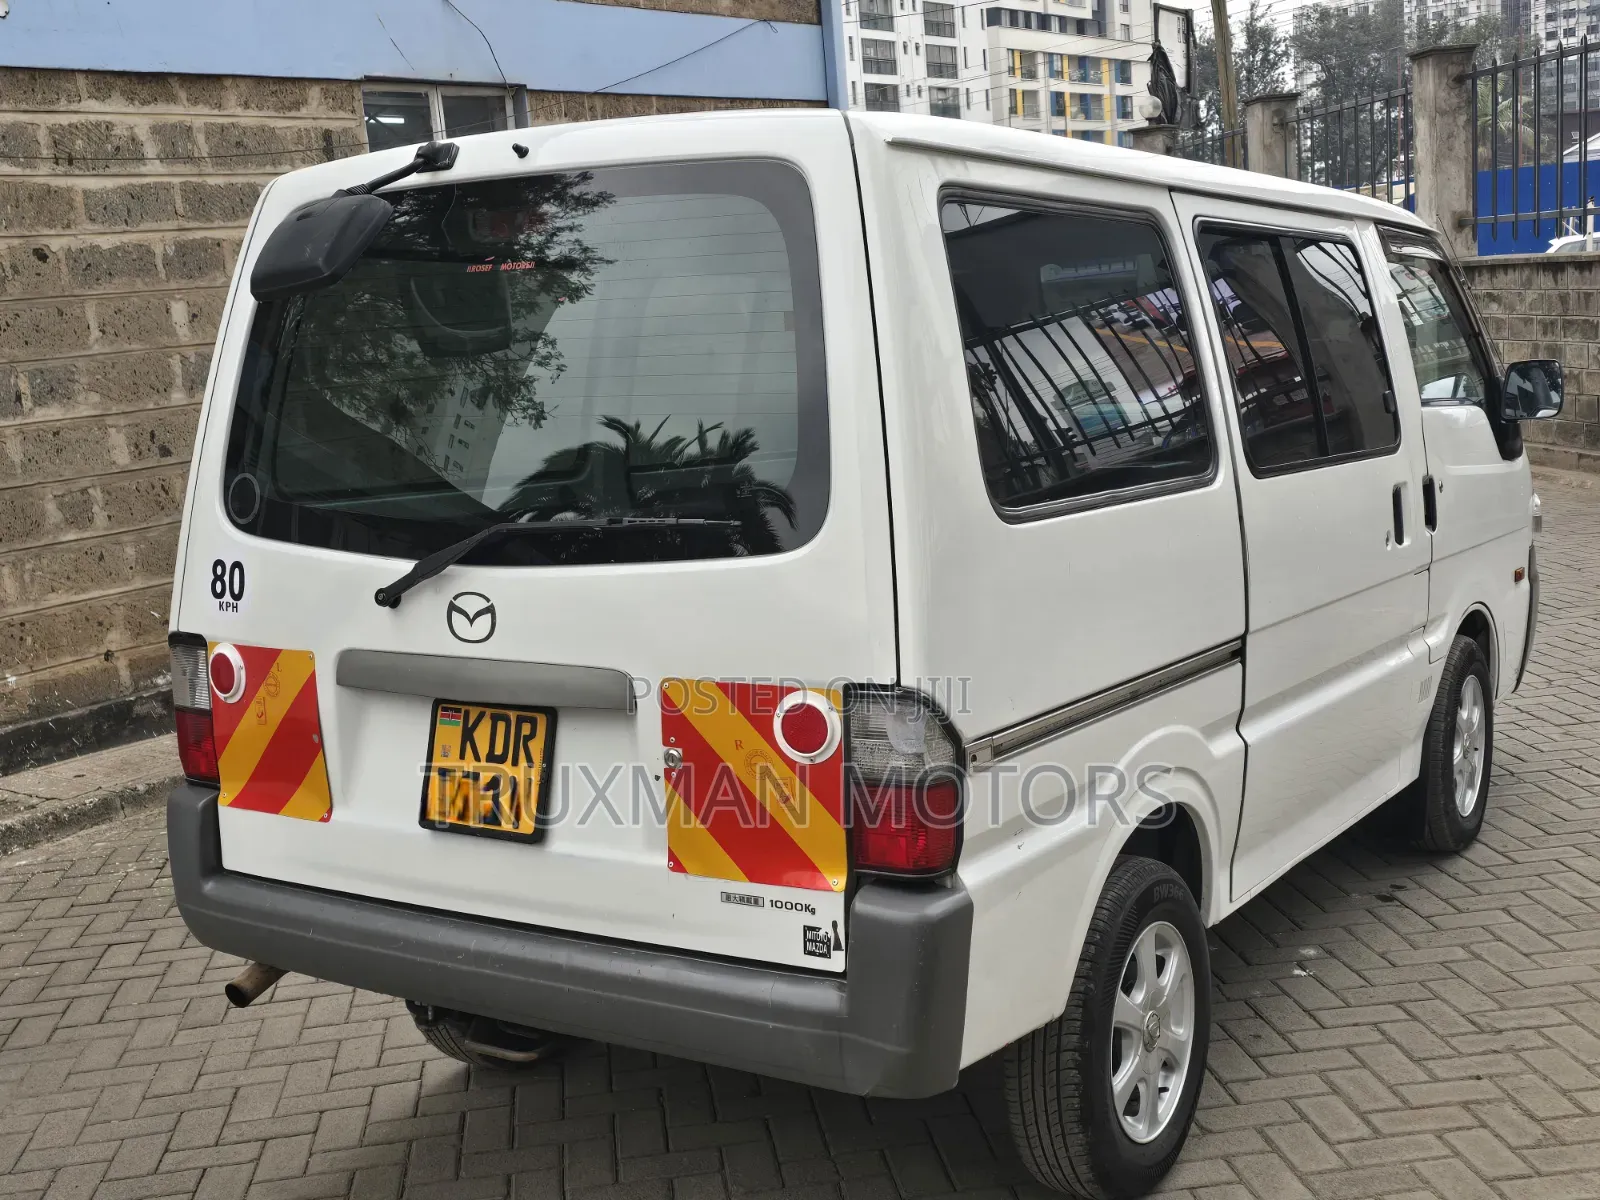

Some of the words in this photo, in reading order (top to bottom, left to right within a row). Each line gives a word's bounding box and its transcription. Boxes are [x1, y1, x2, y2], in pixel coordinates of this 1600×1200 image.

[211, 558, 245, 601] 80
[218, 600, 239, 613] KPH
[459, 709, 539, 769] KDR
[734, 739, 745, 751] R
[806, 941, 828, 954] MAZDA
